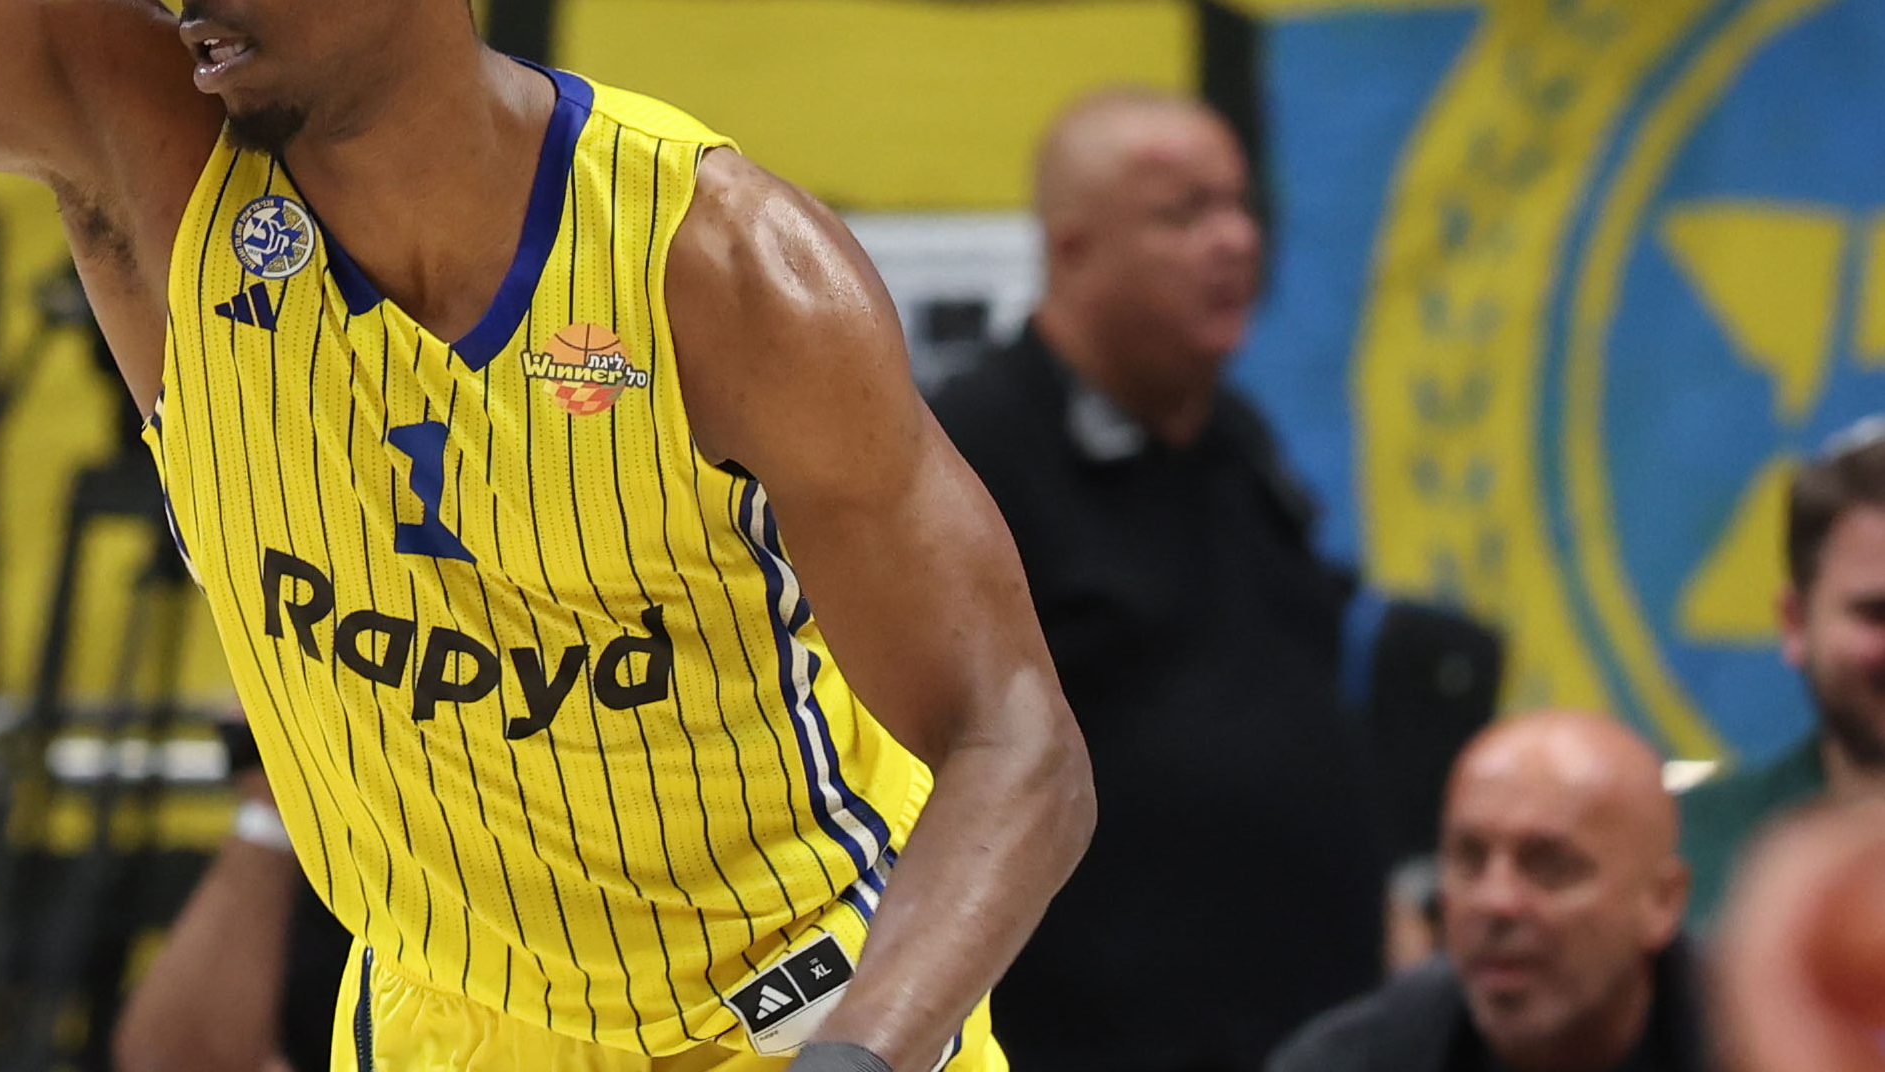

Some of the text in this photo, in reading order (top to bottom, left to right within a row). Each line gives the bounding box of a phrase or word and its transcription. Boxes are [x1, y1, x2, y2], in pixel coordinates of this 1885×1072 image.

[521, 350, 624, 385] Winner
[388, 420, 477, 565] 1
[262, 546, 675, 741] Rapyd
[809, 962, 833, 980] XL
